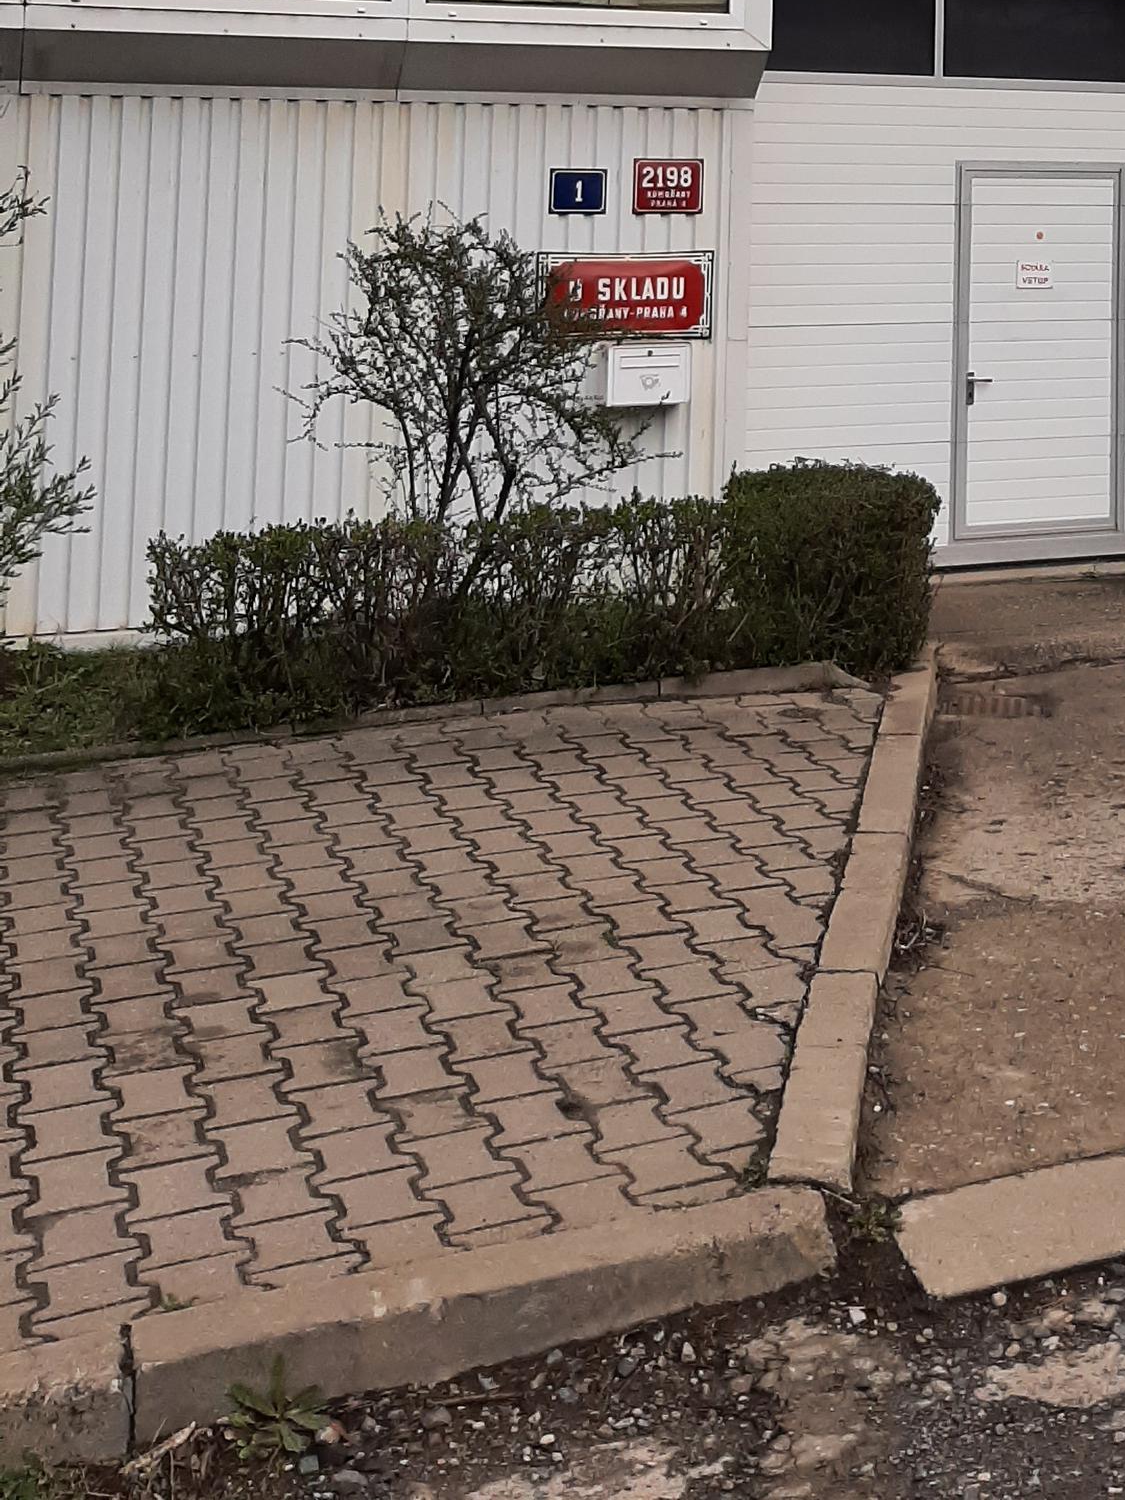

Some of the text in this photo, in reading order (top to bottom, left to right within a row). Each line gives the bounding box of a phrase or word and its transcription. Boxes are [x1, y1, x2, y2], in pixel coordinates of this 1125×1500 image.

[641, 166, 693, 188] 2198
[575, 180, 583, 202] 1
[597, 275, 686, 301] SKLADU
